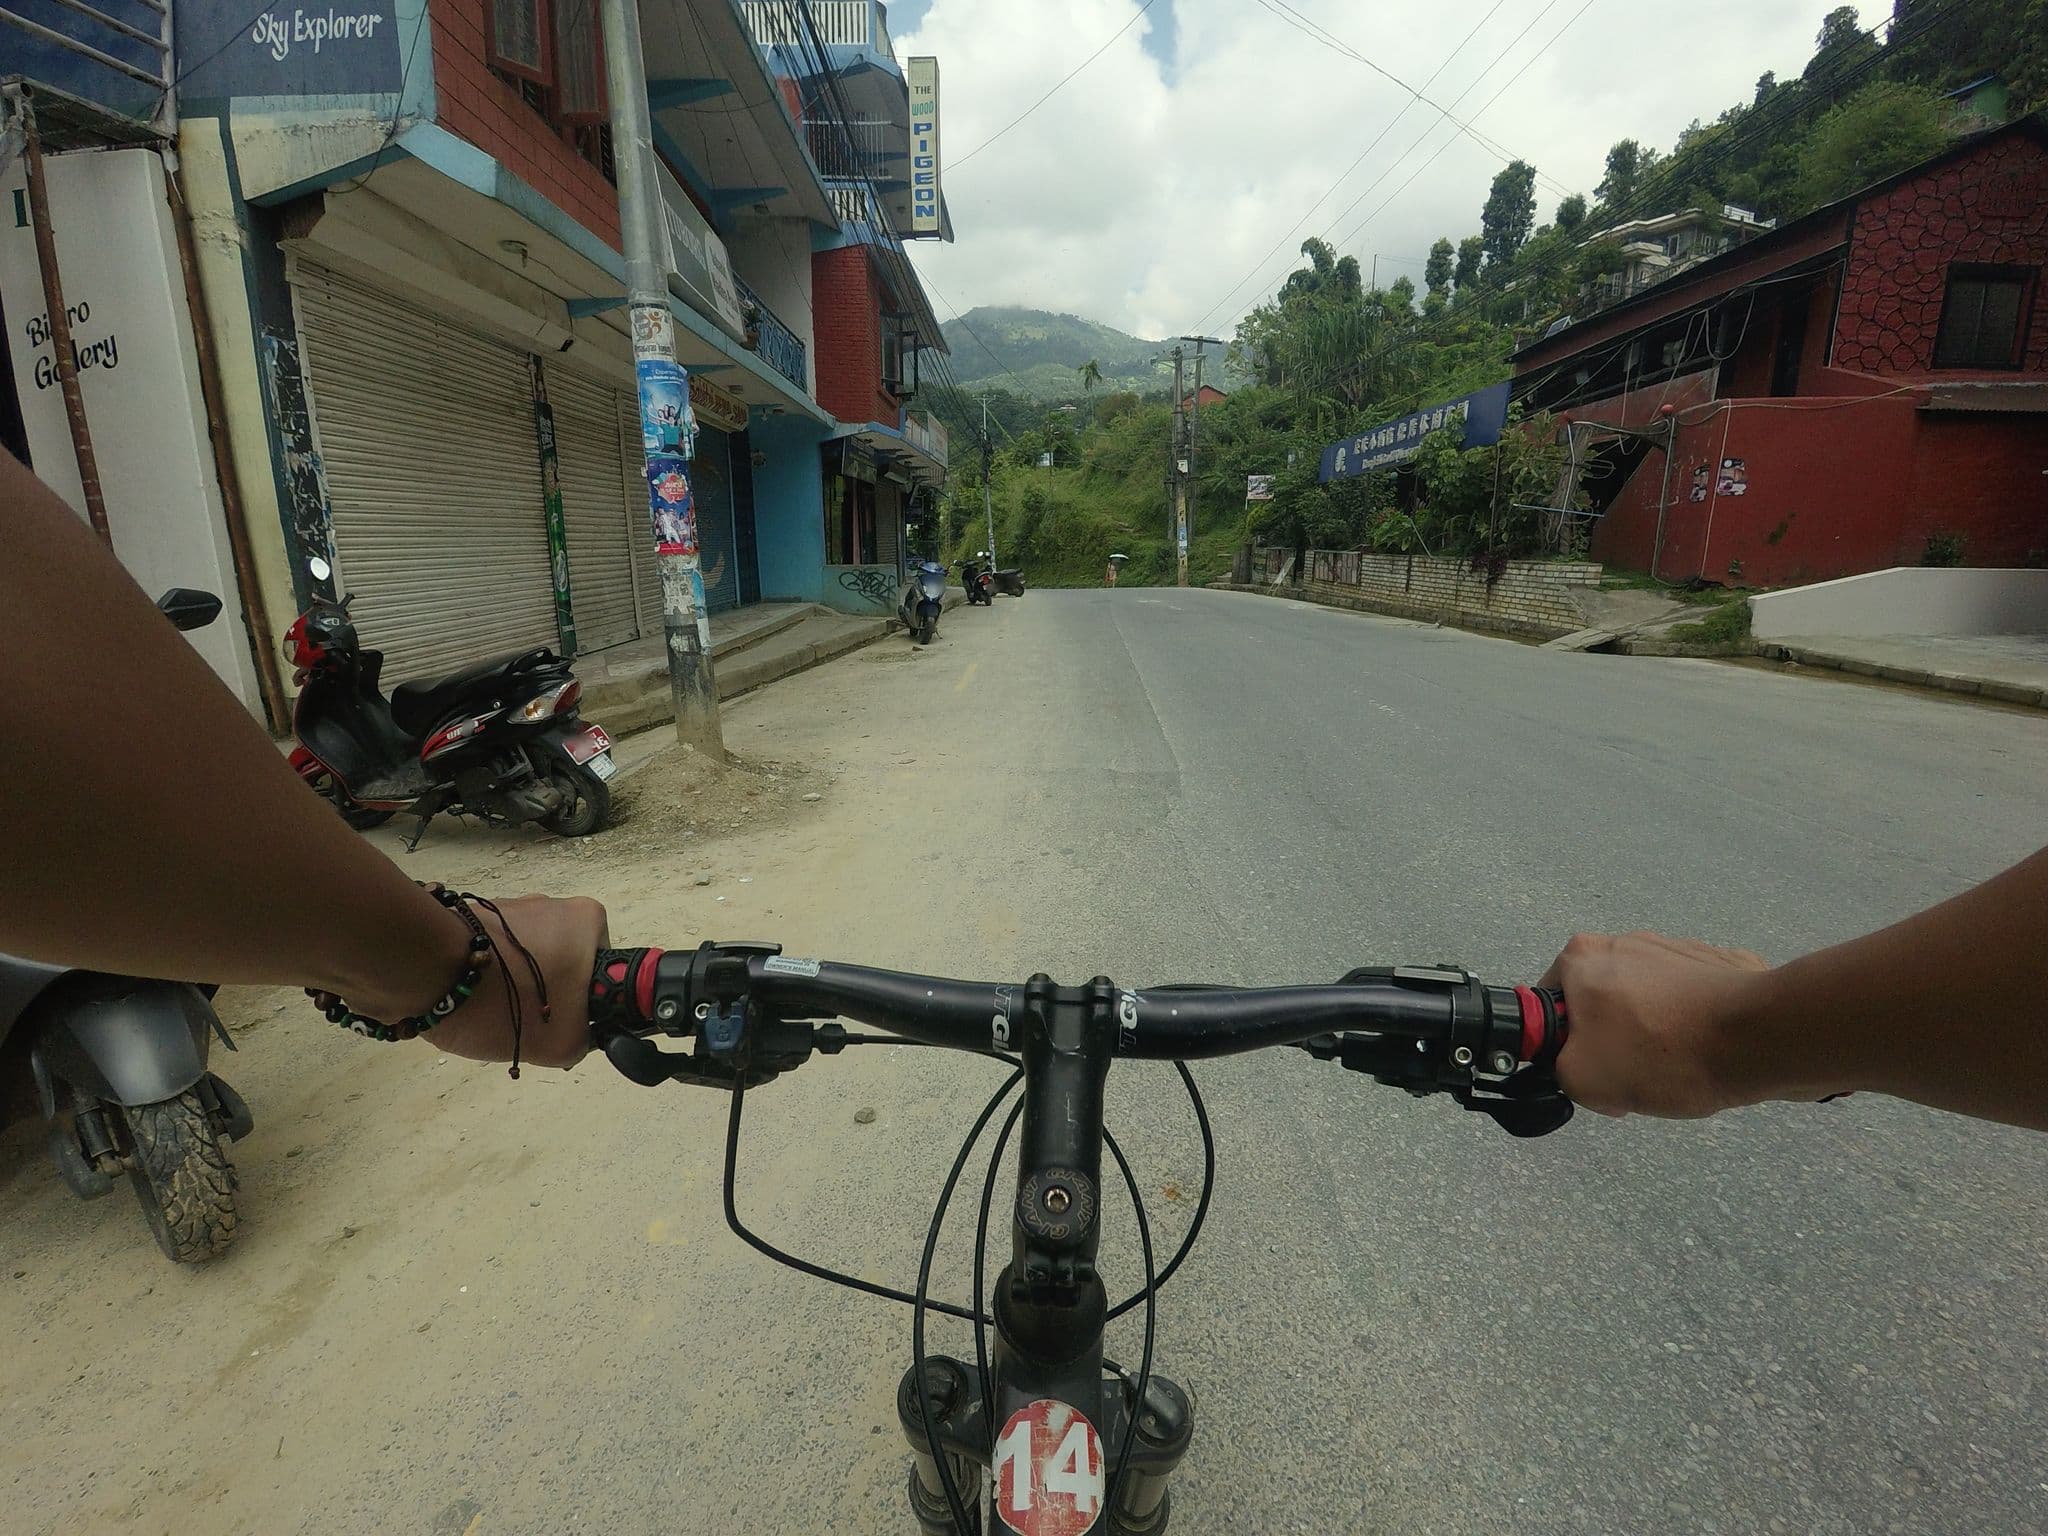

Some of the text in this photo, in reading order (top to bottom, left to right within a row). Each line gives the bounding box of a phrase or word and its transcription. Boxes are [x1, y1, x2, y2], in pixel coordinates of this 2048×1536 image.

[252, 9, 383, 61] Sky Explorer
[911, 101, 934, 116] WOOD
[914, 85, 932, 95] THE
[913, 122, 935, 218] PIGEON
[26, 299, 91, 348] Biro
[33, 334, 119, 391] Galery
[996, 1420, 1098, 1513] 14
